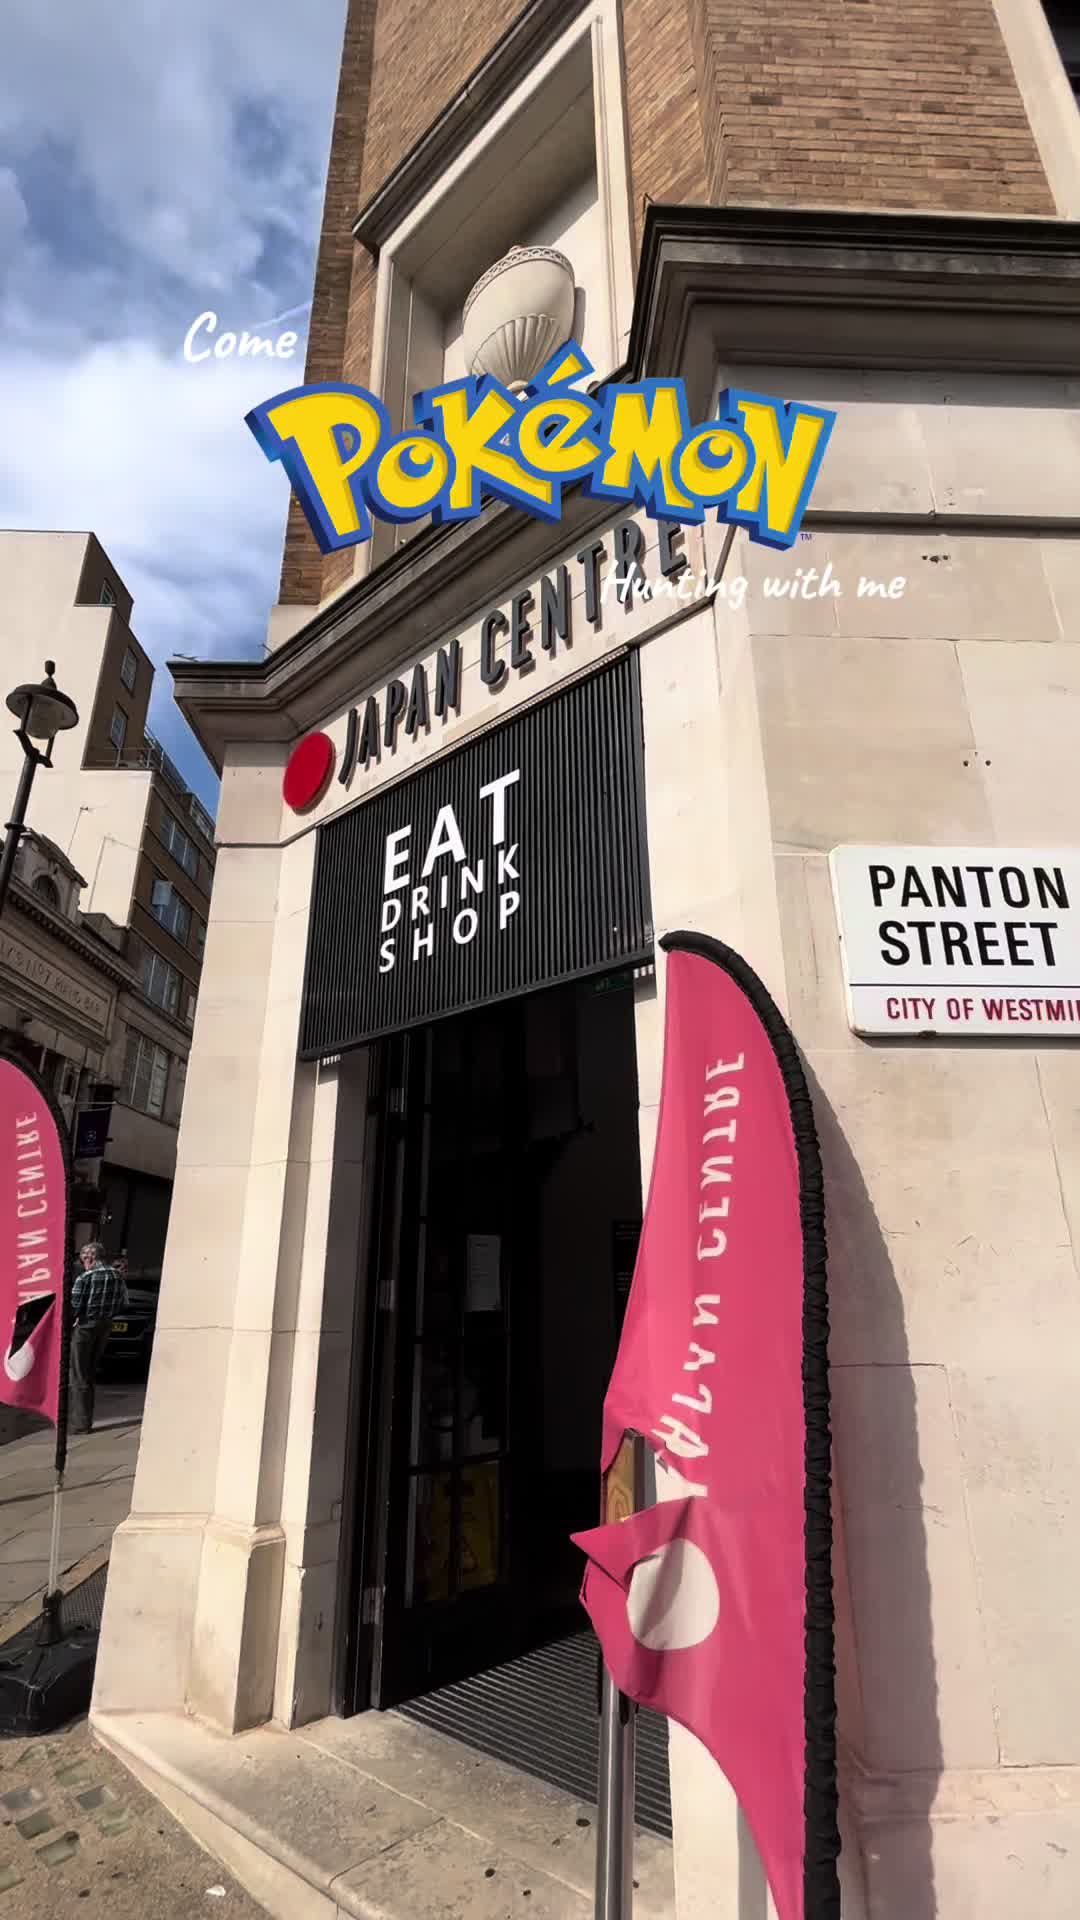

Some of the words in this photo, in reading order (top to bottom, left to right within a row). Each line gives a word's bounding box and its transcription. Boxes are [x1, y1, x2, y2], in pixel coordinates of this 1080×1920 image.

[338, 639, 460, 786] JAPAN
[479, 518, 689, 687] CENTRE
[383, 769, 521, 895] EAT
[380, 842, 520, 933] DRINK
[869, 865, 1070, 909] PANTON
[378, 891, 520, 974] SHOP
[879, 920, 1059, 967] STREET
[886, 997, 936, 1020] CITY
[946, 997, 974, 1021] OF
